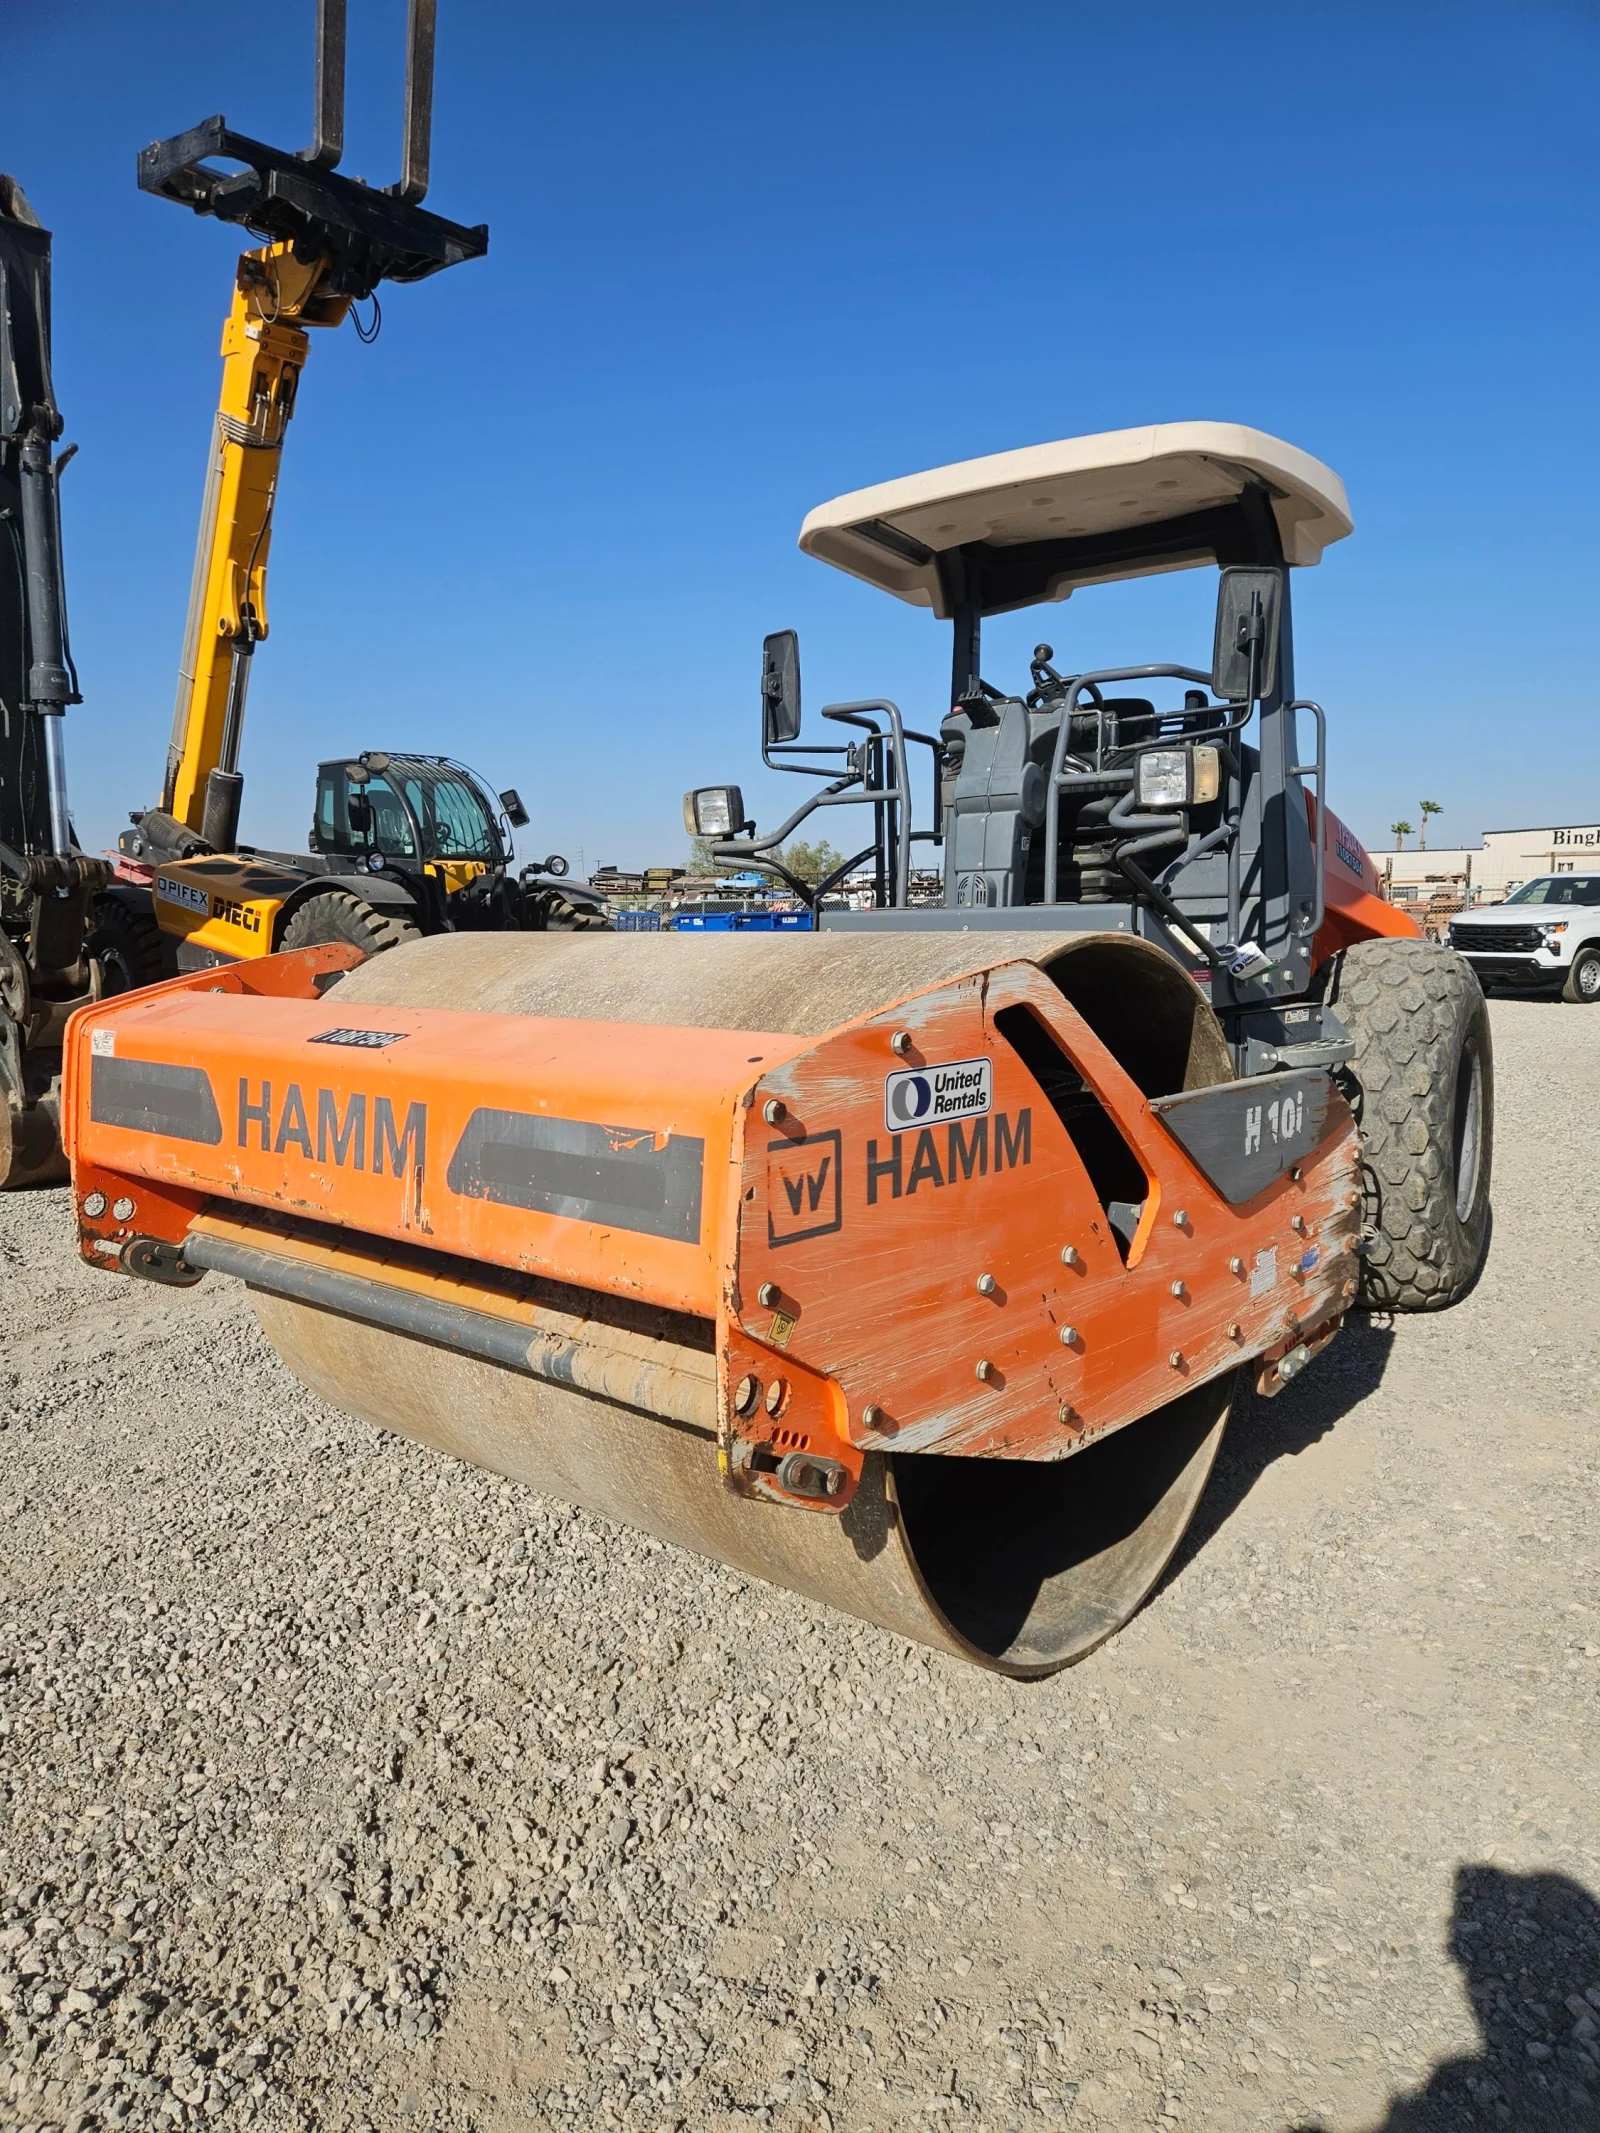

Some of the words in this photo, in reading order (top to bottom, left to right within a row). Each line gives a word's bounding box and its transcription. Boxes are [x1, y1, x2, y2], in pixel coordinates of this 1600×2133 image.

[157, 877, 209, 907] OPIFEX
[934, 1067, 983, 1093] United
[934, 1088, 987, 1114] Rentals
[238, 1077, 428, 1185] HAMM
[1245, 1105, 1262, 1156] H
[866, 1107, 1032, 1206] HAMM
